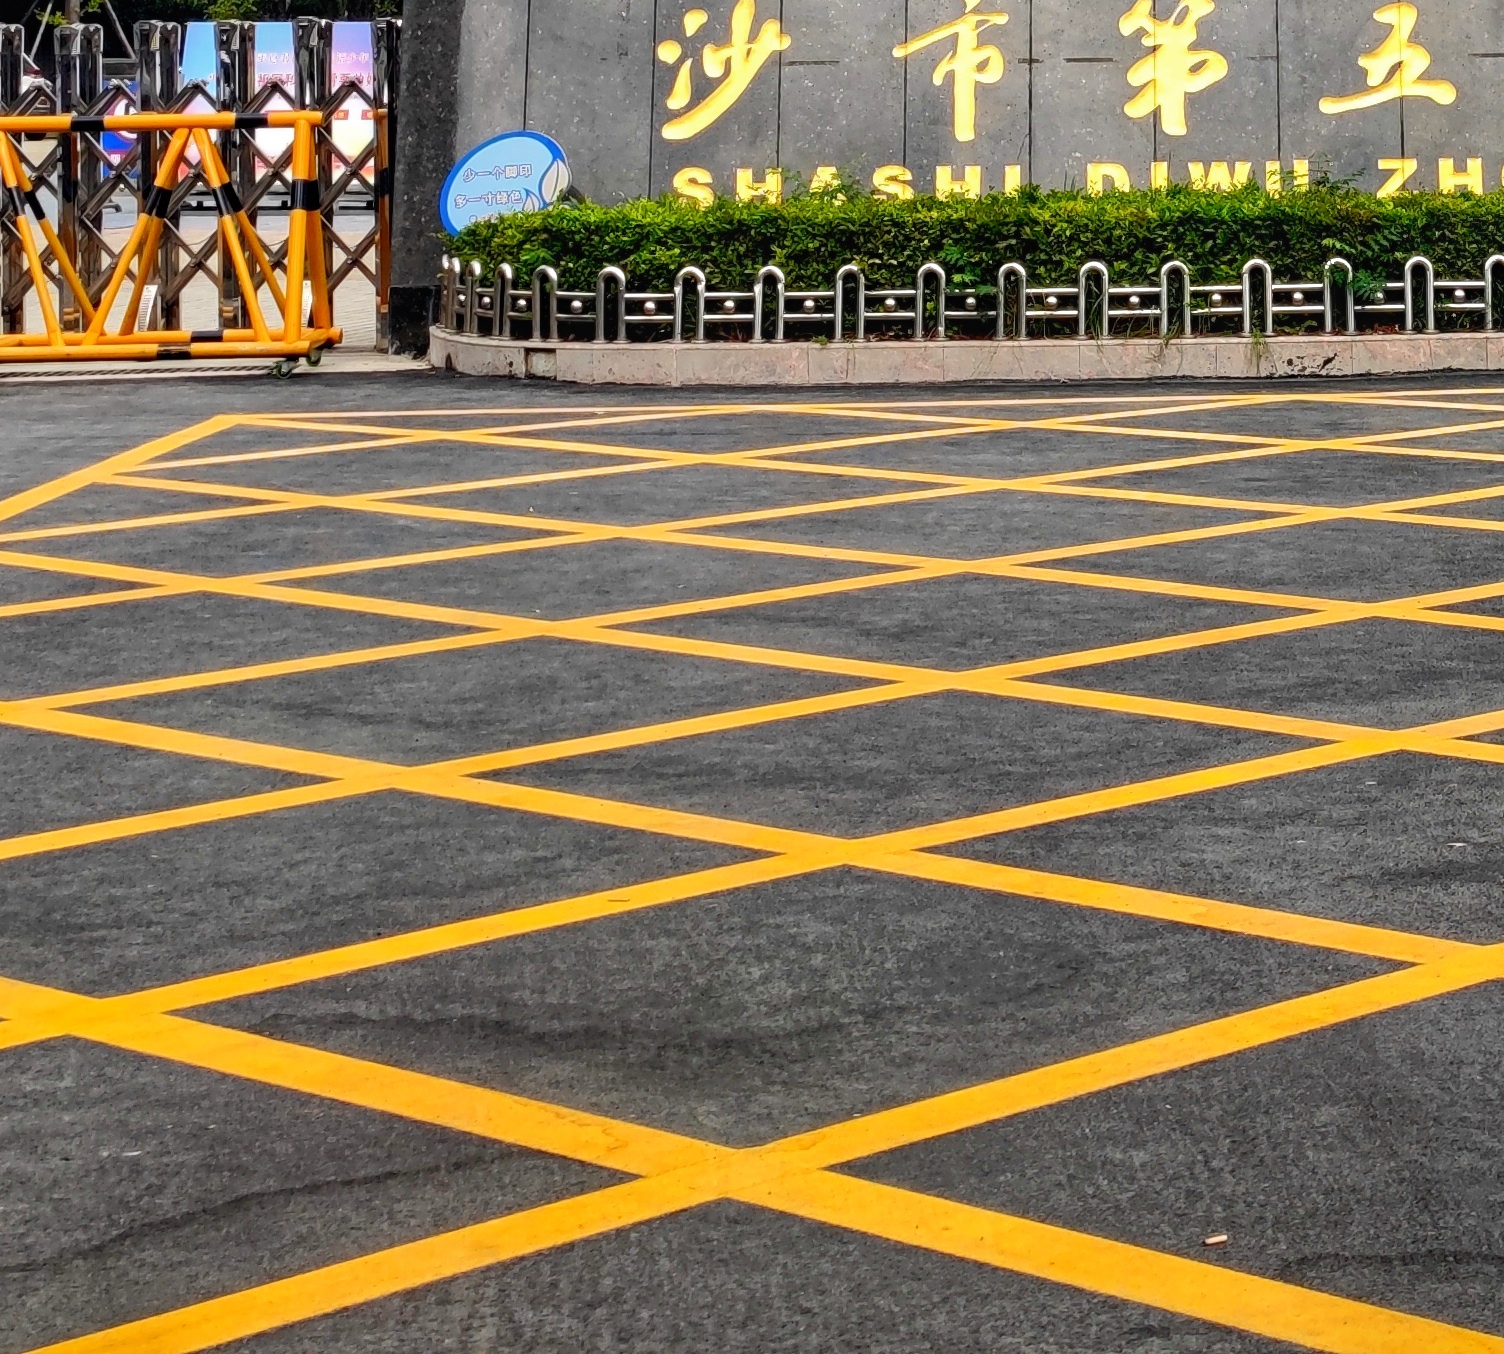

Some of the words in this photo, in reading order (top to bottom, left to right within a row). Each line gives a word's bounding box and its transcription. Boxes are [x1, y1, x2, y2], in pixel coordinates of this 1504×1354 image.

[463, 164, 532, 183] 少一个脚印
[672, 161, 1021, 208] SHASHI
[454, 190, 523, 208] 多一寸绿色
